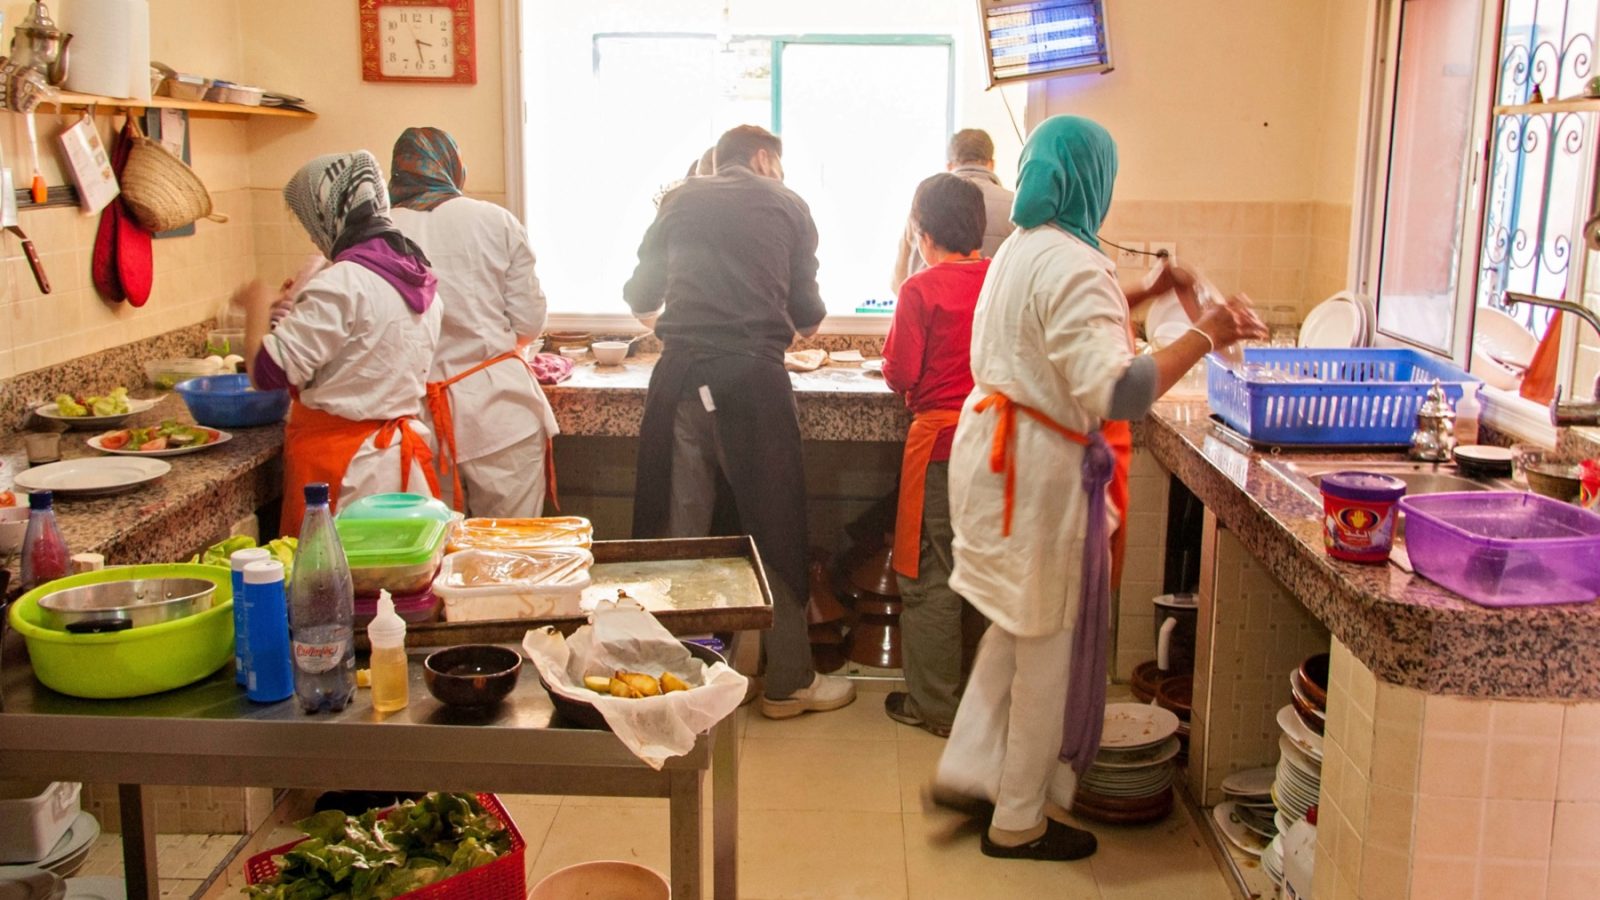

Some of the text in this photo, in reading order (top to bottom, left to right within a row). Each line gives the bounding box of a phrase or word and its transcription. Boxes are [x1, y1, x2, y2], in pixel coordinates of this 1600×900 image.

[400, 13, 407, 23] 11
[412, 13, 422, 23] 12
[388, 21, 397, 31] 10
[440, 21, 447, 32] 2
[388, 36, 395, 45] 9
[442, 37, 448, 48] 3
[389, 52, 396, 63] 8
[415, 61, 422, 70] 6
[429, 60, 436, 70] 5
